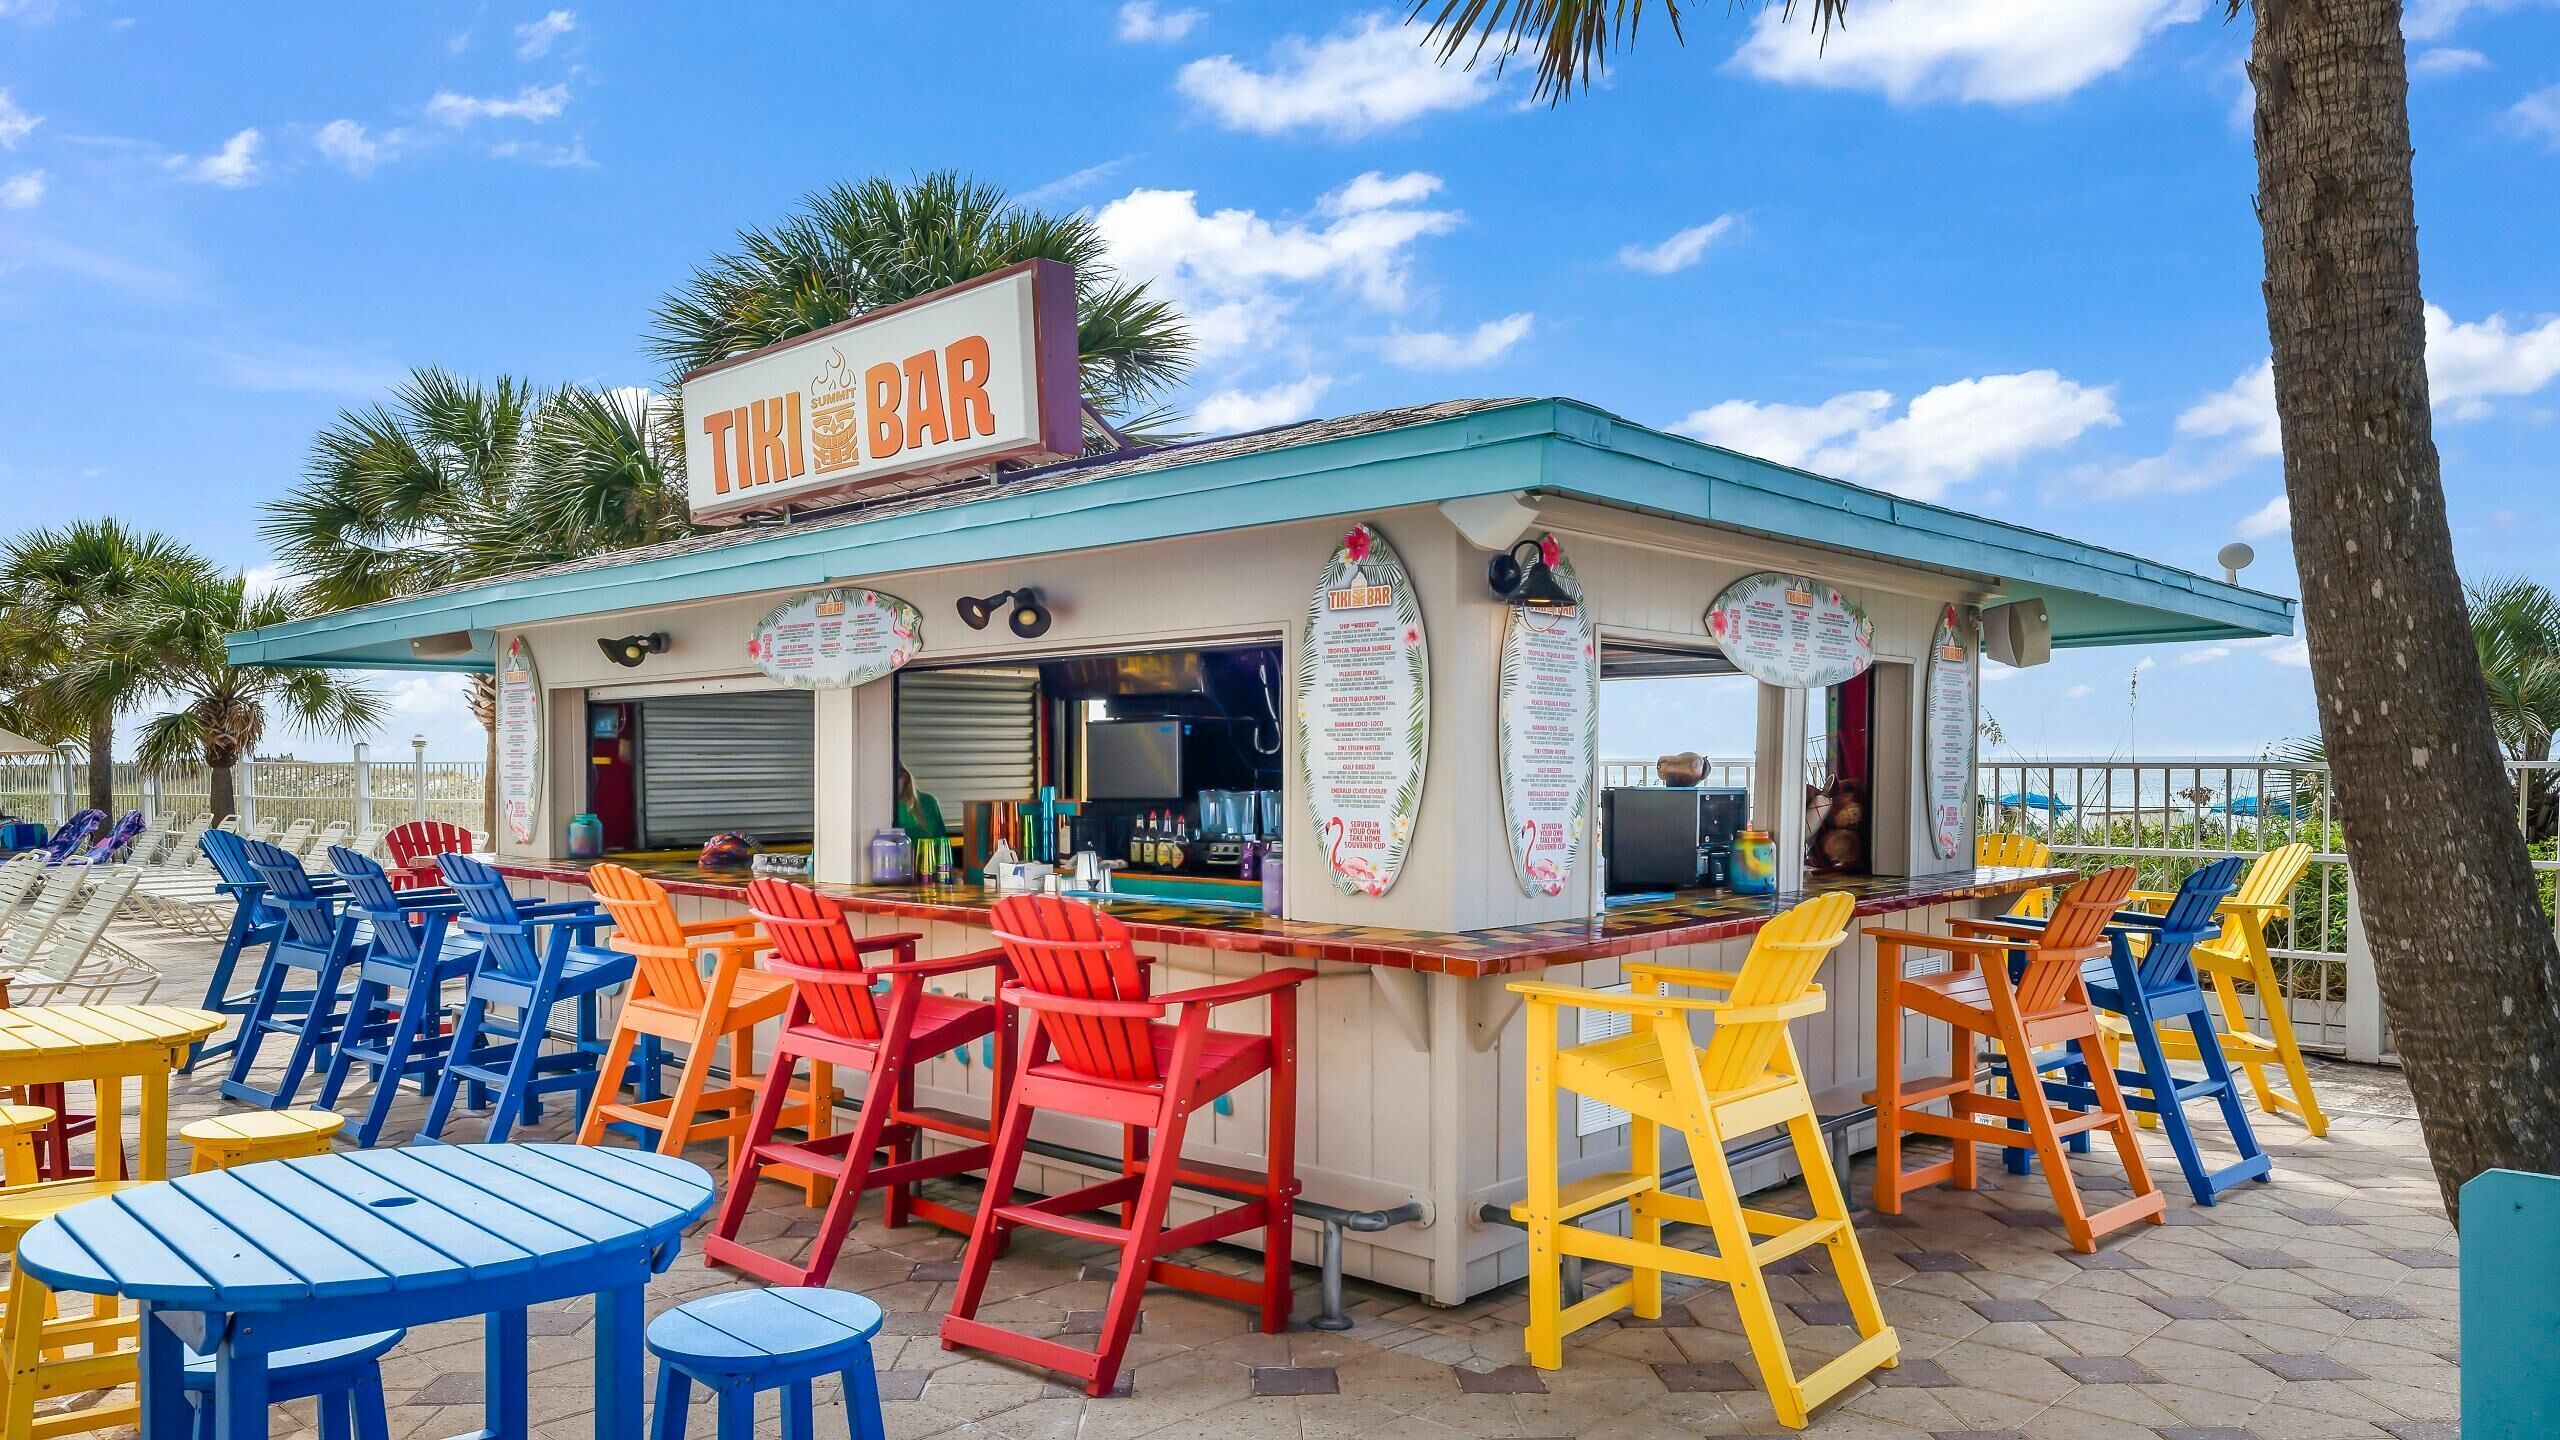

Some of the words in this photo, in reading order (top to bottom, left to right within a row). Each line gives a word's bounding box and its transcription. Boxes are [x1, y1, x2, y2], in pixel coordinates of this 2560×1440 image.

[810, 387, 857, 409] SUMMIT
[704, 391, 806, 495] TIKI
[865, 335, 996, 459] BAR
[1330, 591, 1352, 608] TIKI
[1367, 587, 1391, 605] BAR
[1351, 646, 1371, 654] TEQUILA
